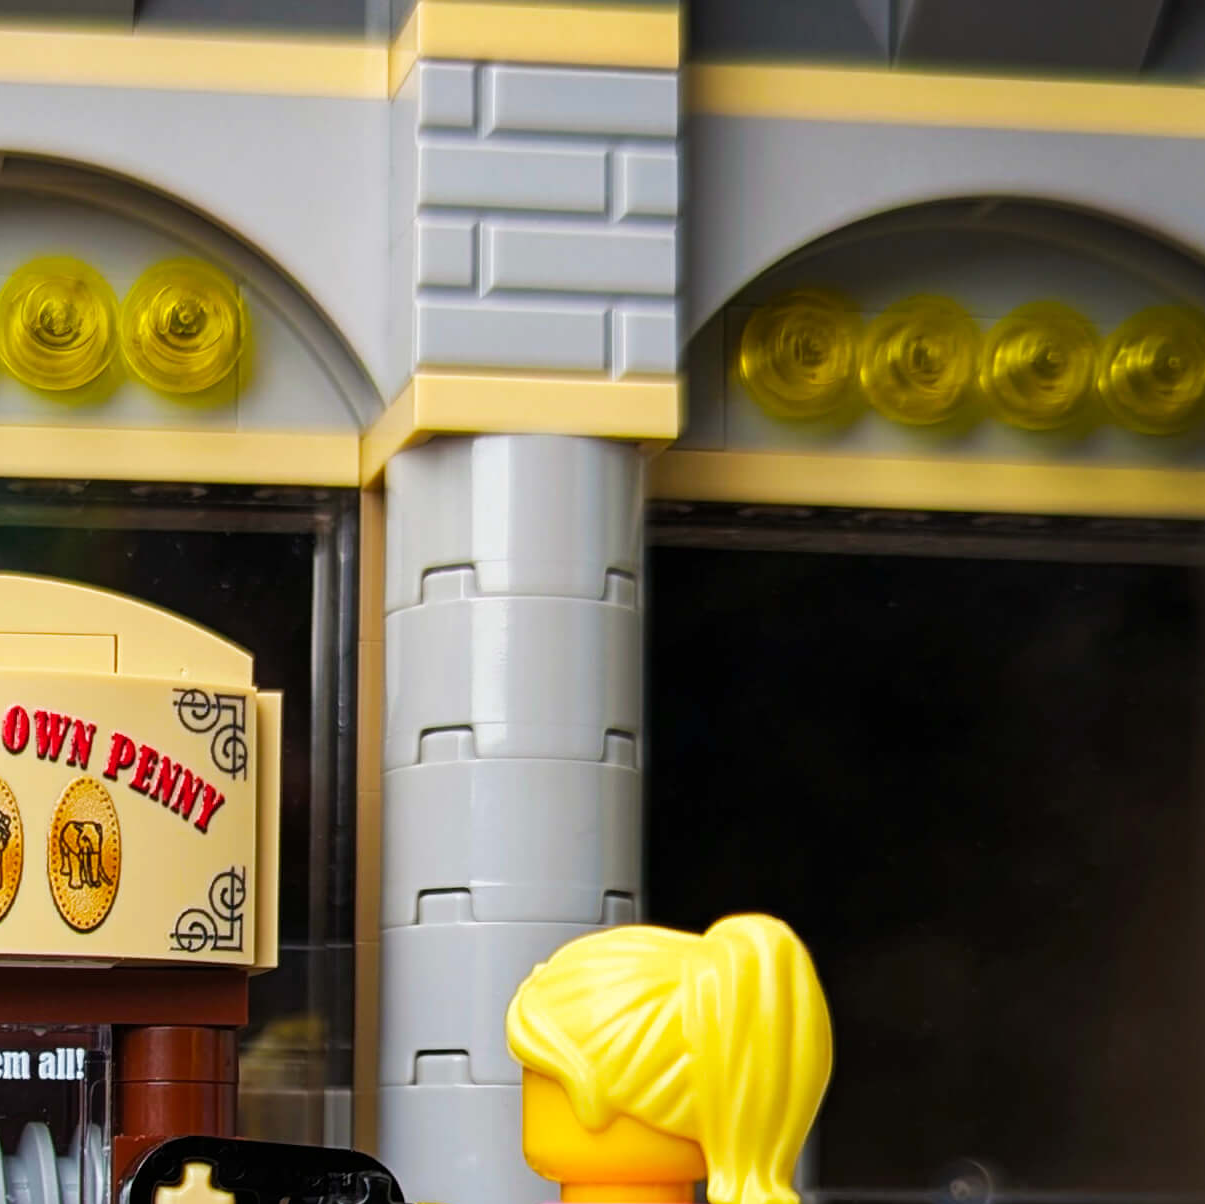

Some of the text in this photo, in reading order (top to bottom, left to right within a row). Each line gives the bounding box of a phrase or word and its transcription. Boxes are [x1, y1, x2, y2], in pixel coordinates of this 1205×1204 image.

[1, 705, 98, 769] OWN
[102, 731, 227, 835] PENNY
[38, 1048, 86, 1081] all!
